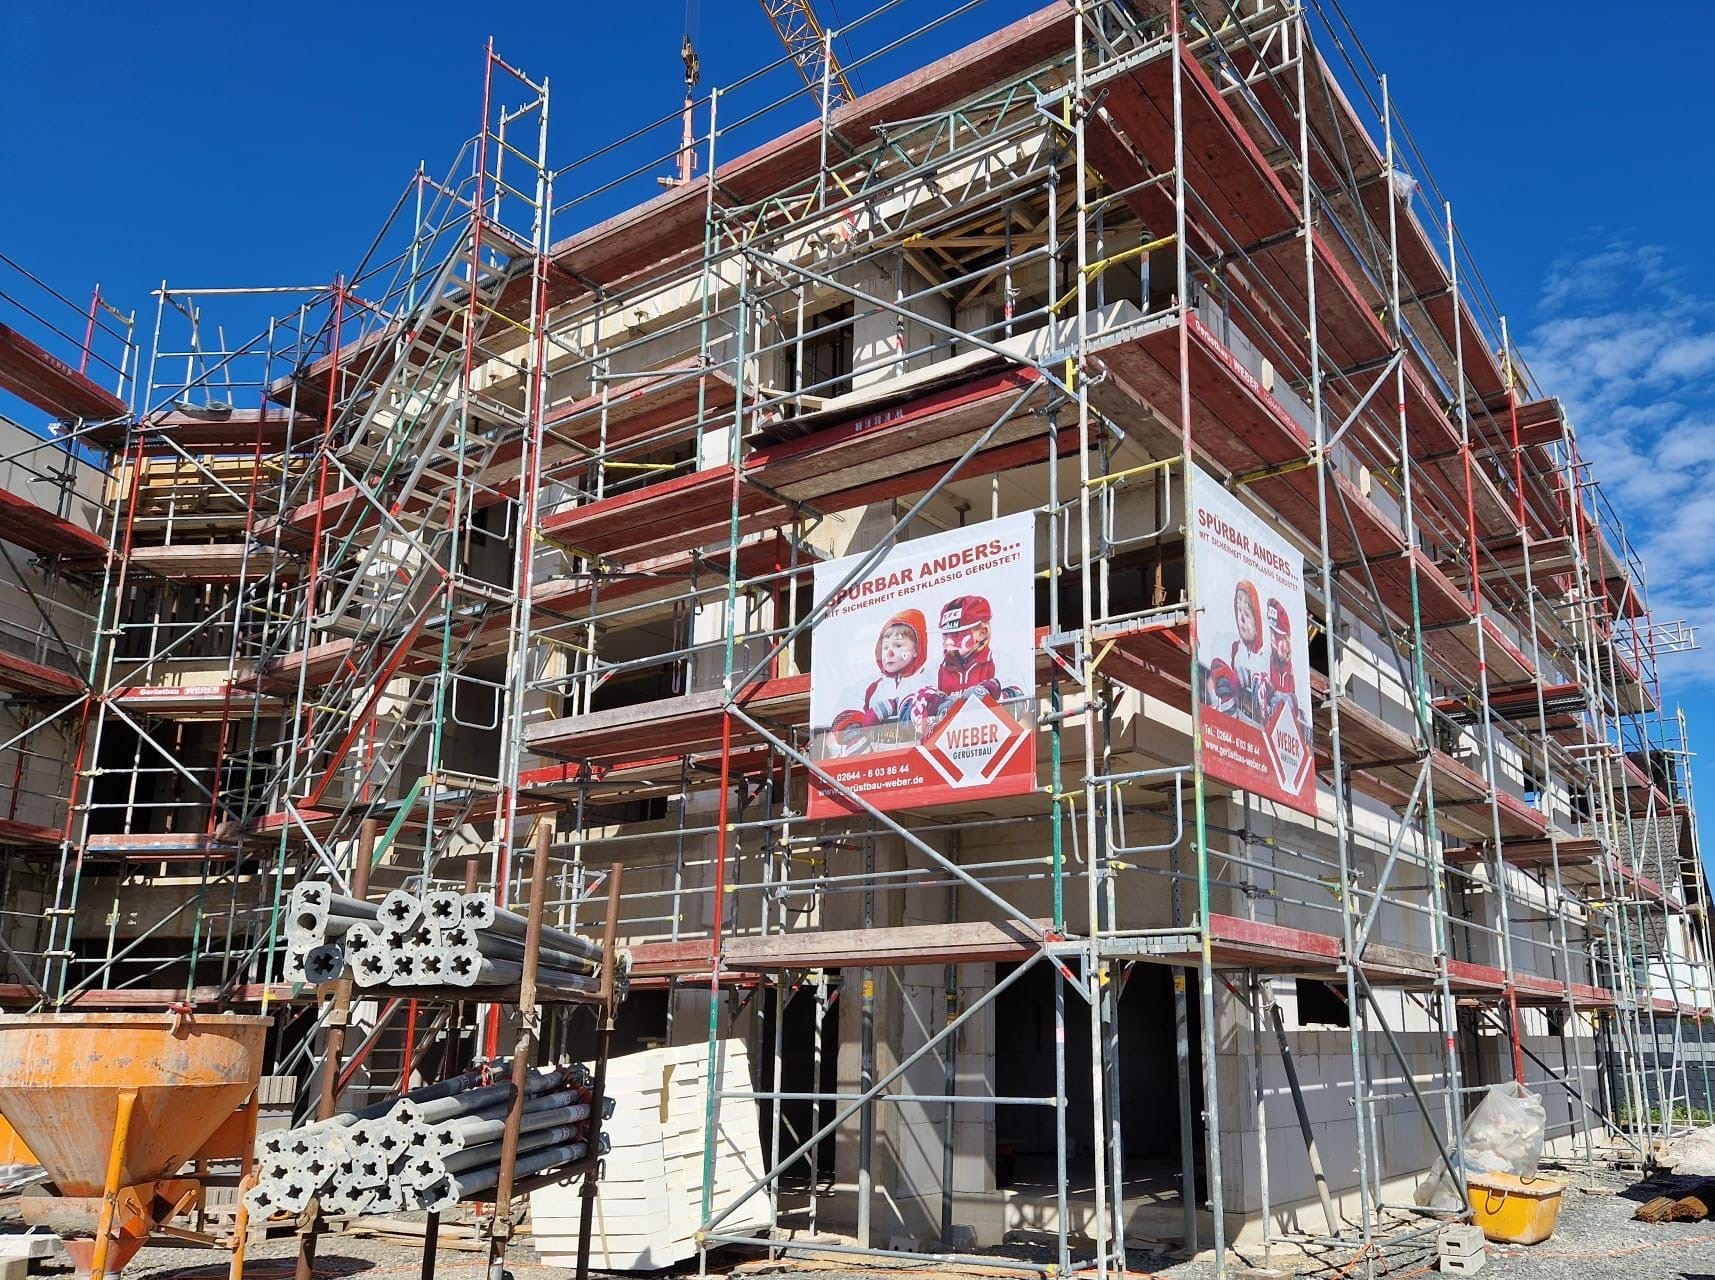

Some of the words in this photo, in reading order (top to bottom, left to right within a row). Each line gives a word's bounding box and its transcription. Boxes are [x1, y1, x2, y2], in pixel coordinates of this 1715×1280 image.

[1198, 508, 1250, 553] SPÜRBAR
[1199, 530, 1210, 541] MIT
[1211, 537, 1242, 560] SICHERHEIT
[919, 539, 1021, 578] ANDERS...
[842, 593, 895, 614] SICHERHEIT
[898, 572, 963, 597] ERSTKLASSIG
[965, 552, 1021, 576] GERÜSTET!
[946, 723, 999, 750] WEBER
[1276, 728, 1300, 758] WEBER
[952, 746, 992, 760] GERÜSTBAU
[836, 771, 861, 782] 02644
[875, 768, 885, 777] 03
[899, 764, 909, 773] 44
